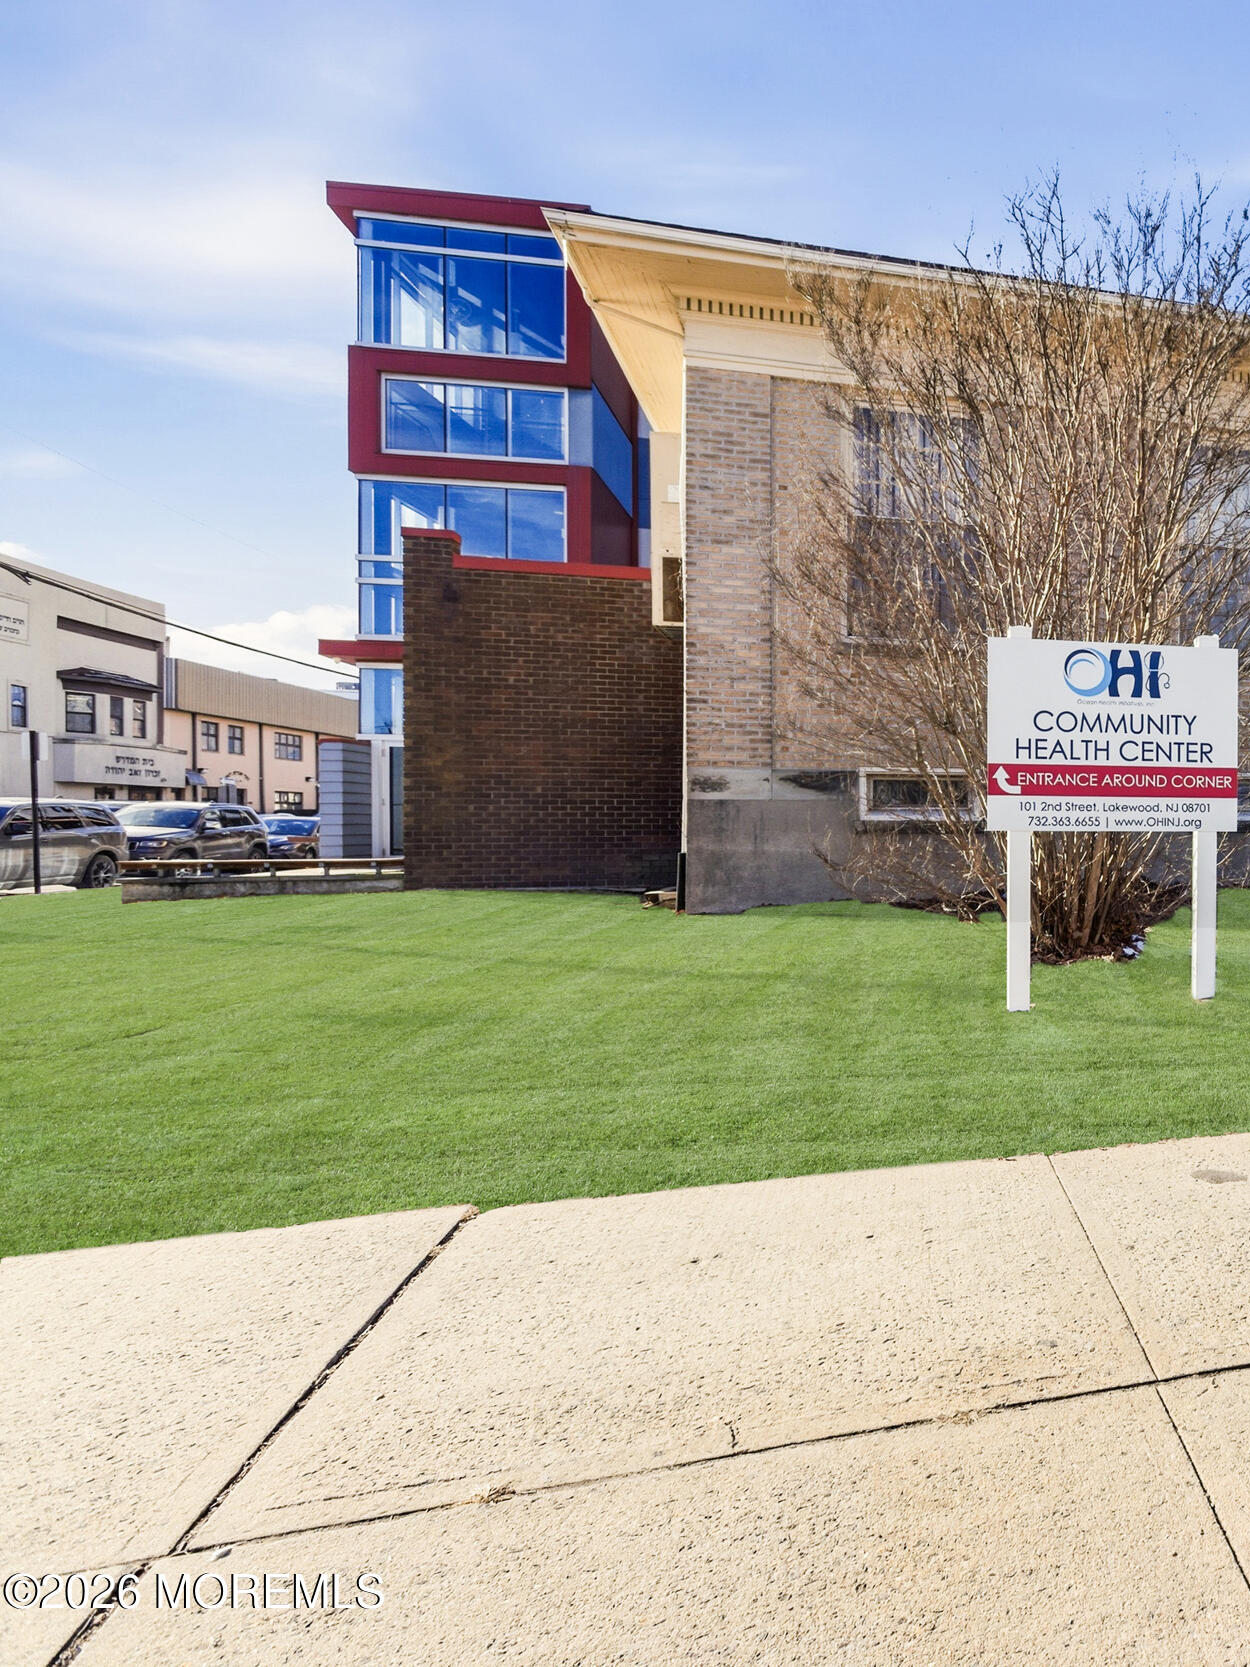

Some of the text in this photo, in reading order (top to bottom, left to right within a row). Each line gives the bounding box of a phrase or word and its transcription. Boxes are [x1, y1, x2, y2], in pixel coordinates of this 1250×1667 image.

[1064, 648, 1170, 698] OHI
[1033, 710, 1197, 736] COMMUNITY
[1015, 738, 1213, 764] HEALTH CENTER
[1017, 772, 1232, 788] ENTRANCE AROUND CORNER
[1019, 802, 1036, 812] 101
[1040, 802, 1062, 812] 2nd
[1166, 804, 1179, 813] NJ
[1181, 804, 1211, 813] 08701
[1028, 816, 1101, 827] 732.363.6655
[1114, 817, 1202, 829] www.OHINJ.org
